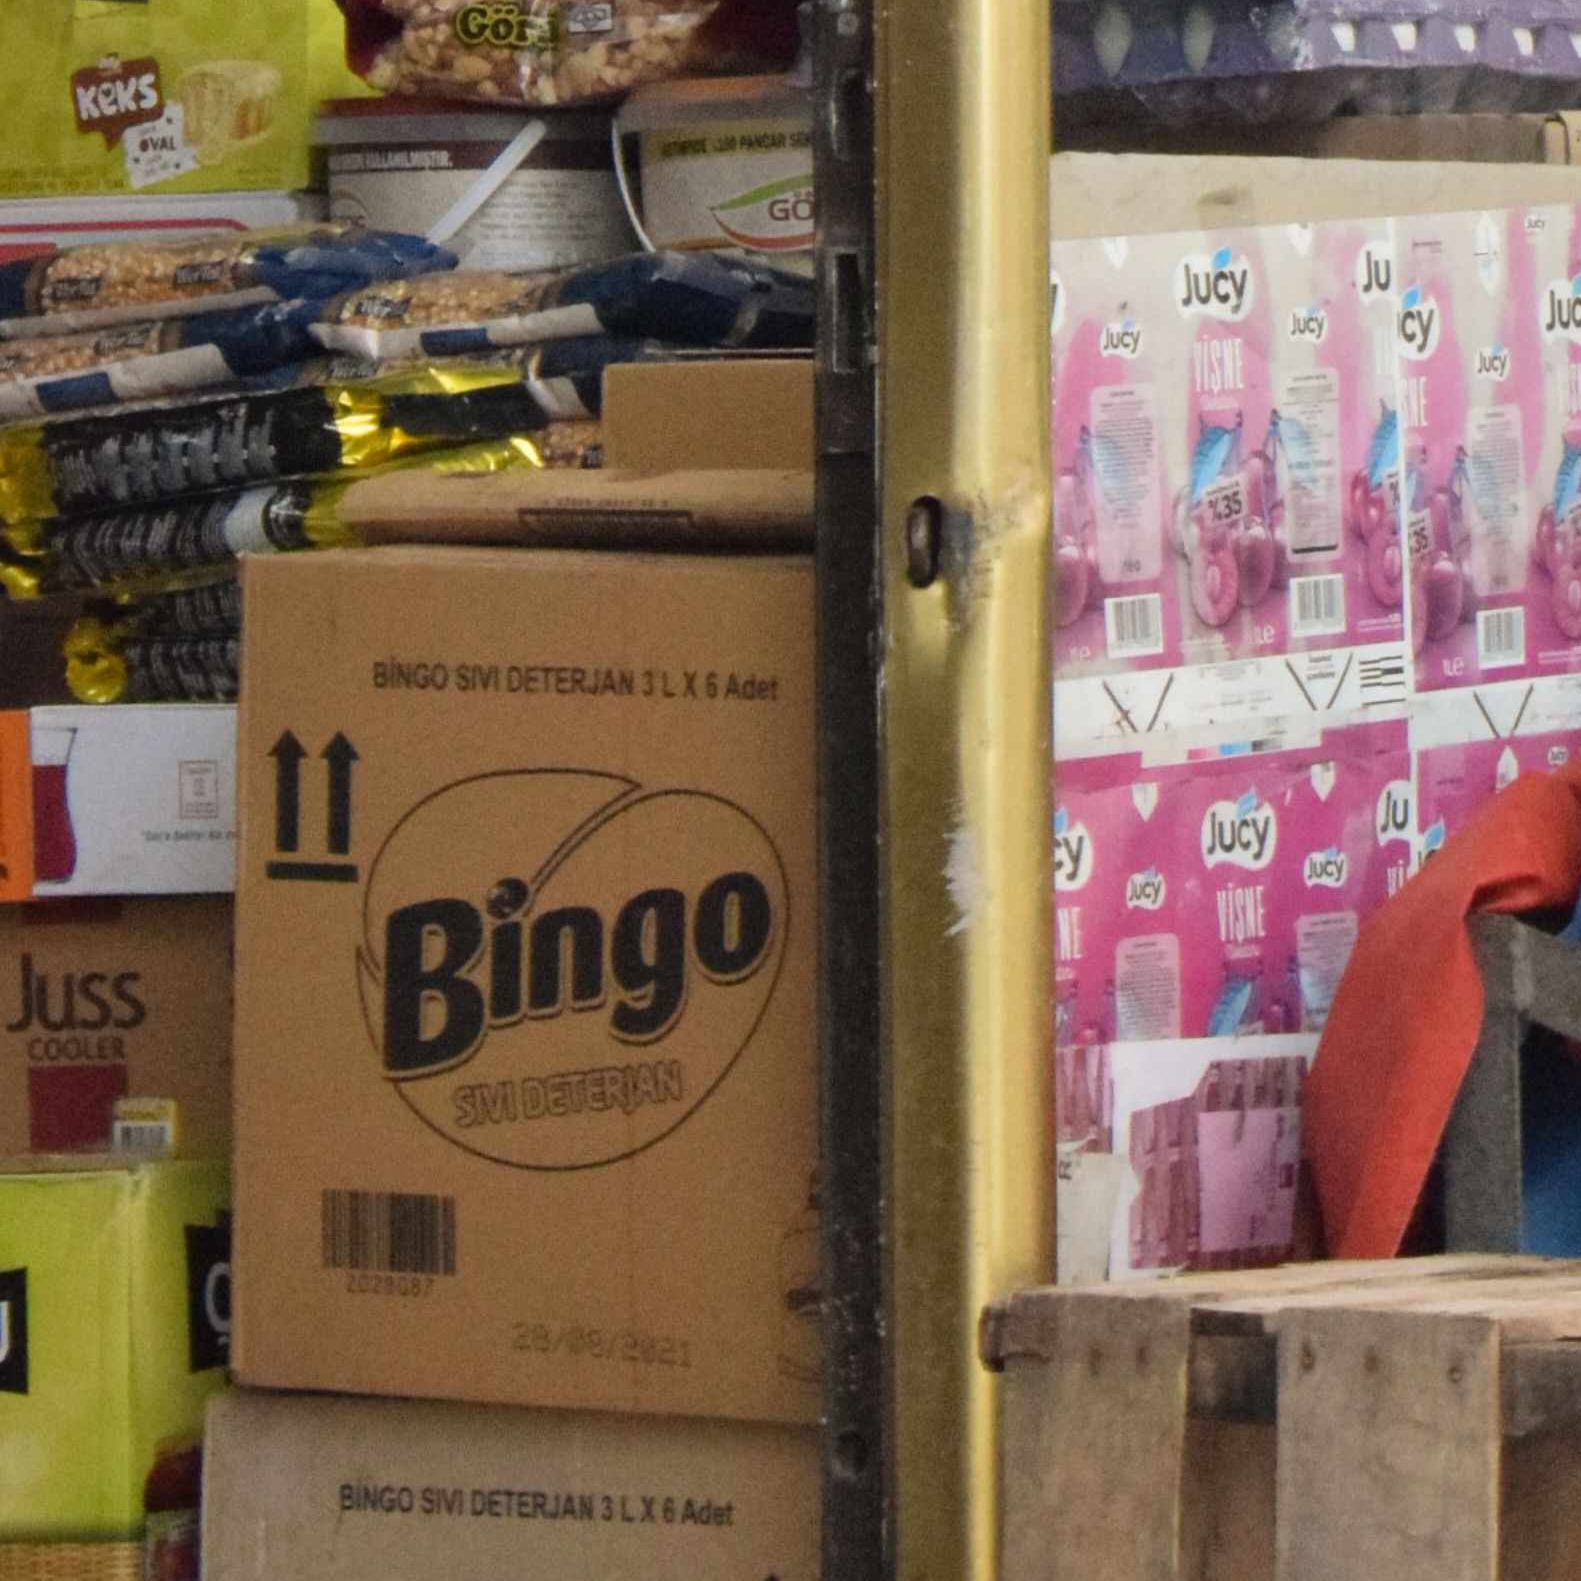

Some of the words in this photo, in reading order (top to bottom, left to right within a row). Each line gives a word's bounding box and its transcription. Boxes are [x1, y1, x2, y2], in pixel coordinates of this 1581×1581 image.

[1181, 262, 1249, 314] Jucy
[1103, 326, 1142, 354] Jucy
[1290, 310, 1326, 339] Jucy
[1477, 351, 1508, 377] Jucy
[1207, 488, 1244, 522] %35
[506, 665, 635, 697] DETERJAN
[641, 670, 655, 697] 3
[661, 671, 675, 699] L
[683, 671, 698, 699] X
[704, 672, 718, 700] 6
[723, 672, 778, 702] Adet
[1207, 808, 1271, 858] Jucy
[1306, 856, 1346, 884] Jucy
[1128, 877, 1162, 906] Jucy
[1216, 883, 1266, 946] VİŞNE
[6, 954, 146, 1031] Juss
[383, 872, 772, 1078] Bingo
[28, 1037, 126, 1061] COOLER
[523, 1060, 684, 1118] DETERJAN
[470, 1488, 594, 1521] DETERJAN
[600, 1495, 613, 1522] 3
[621, 1496, 634, 1522] L
[641, 1496, 655, 1523] X
[663, 1496, 675, 1524] 6
[681, 1497, 735, 1526] Adet
